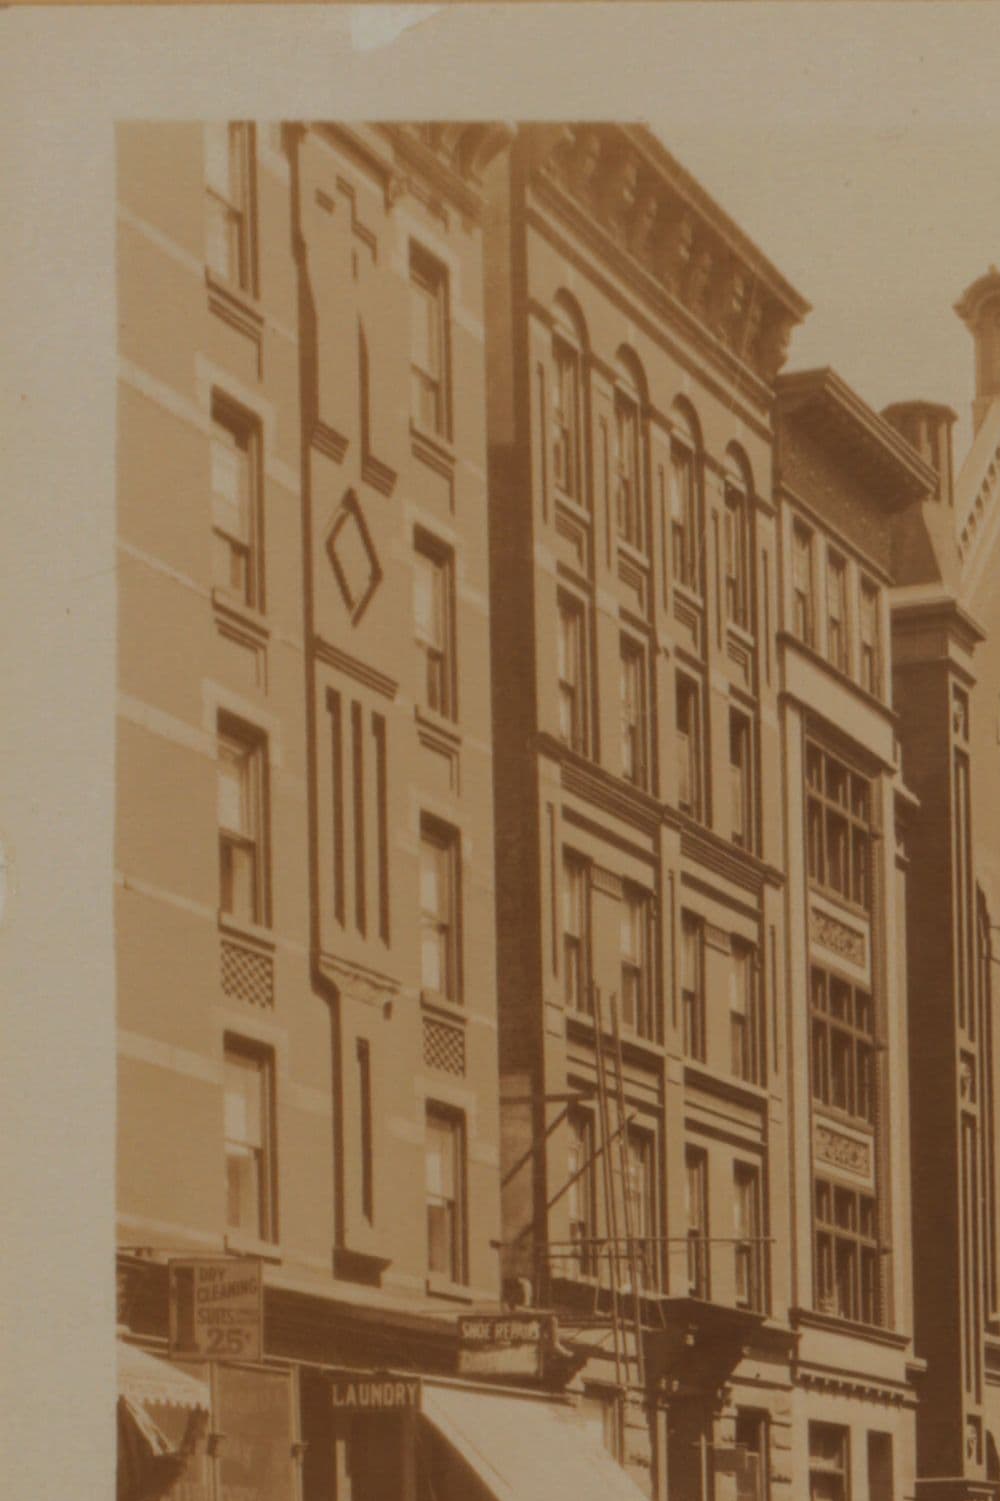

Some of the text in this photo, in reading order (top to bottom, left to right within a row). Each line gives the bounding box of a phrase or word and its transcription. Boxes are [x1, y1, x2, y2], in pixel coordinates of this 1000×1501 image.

[199, 1267, 226, 1281] DRY
[461, 1320, 490, 1340] SHOE
[331, 1382, 418, 1407] LAUNDRY
